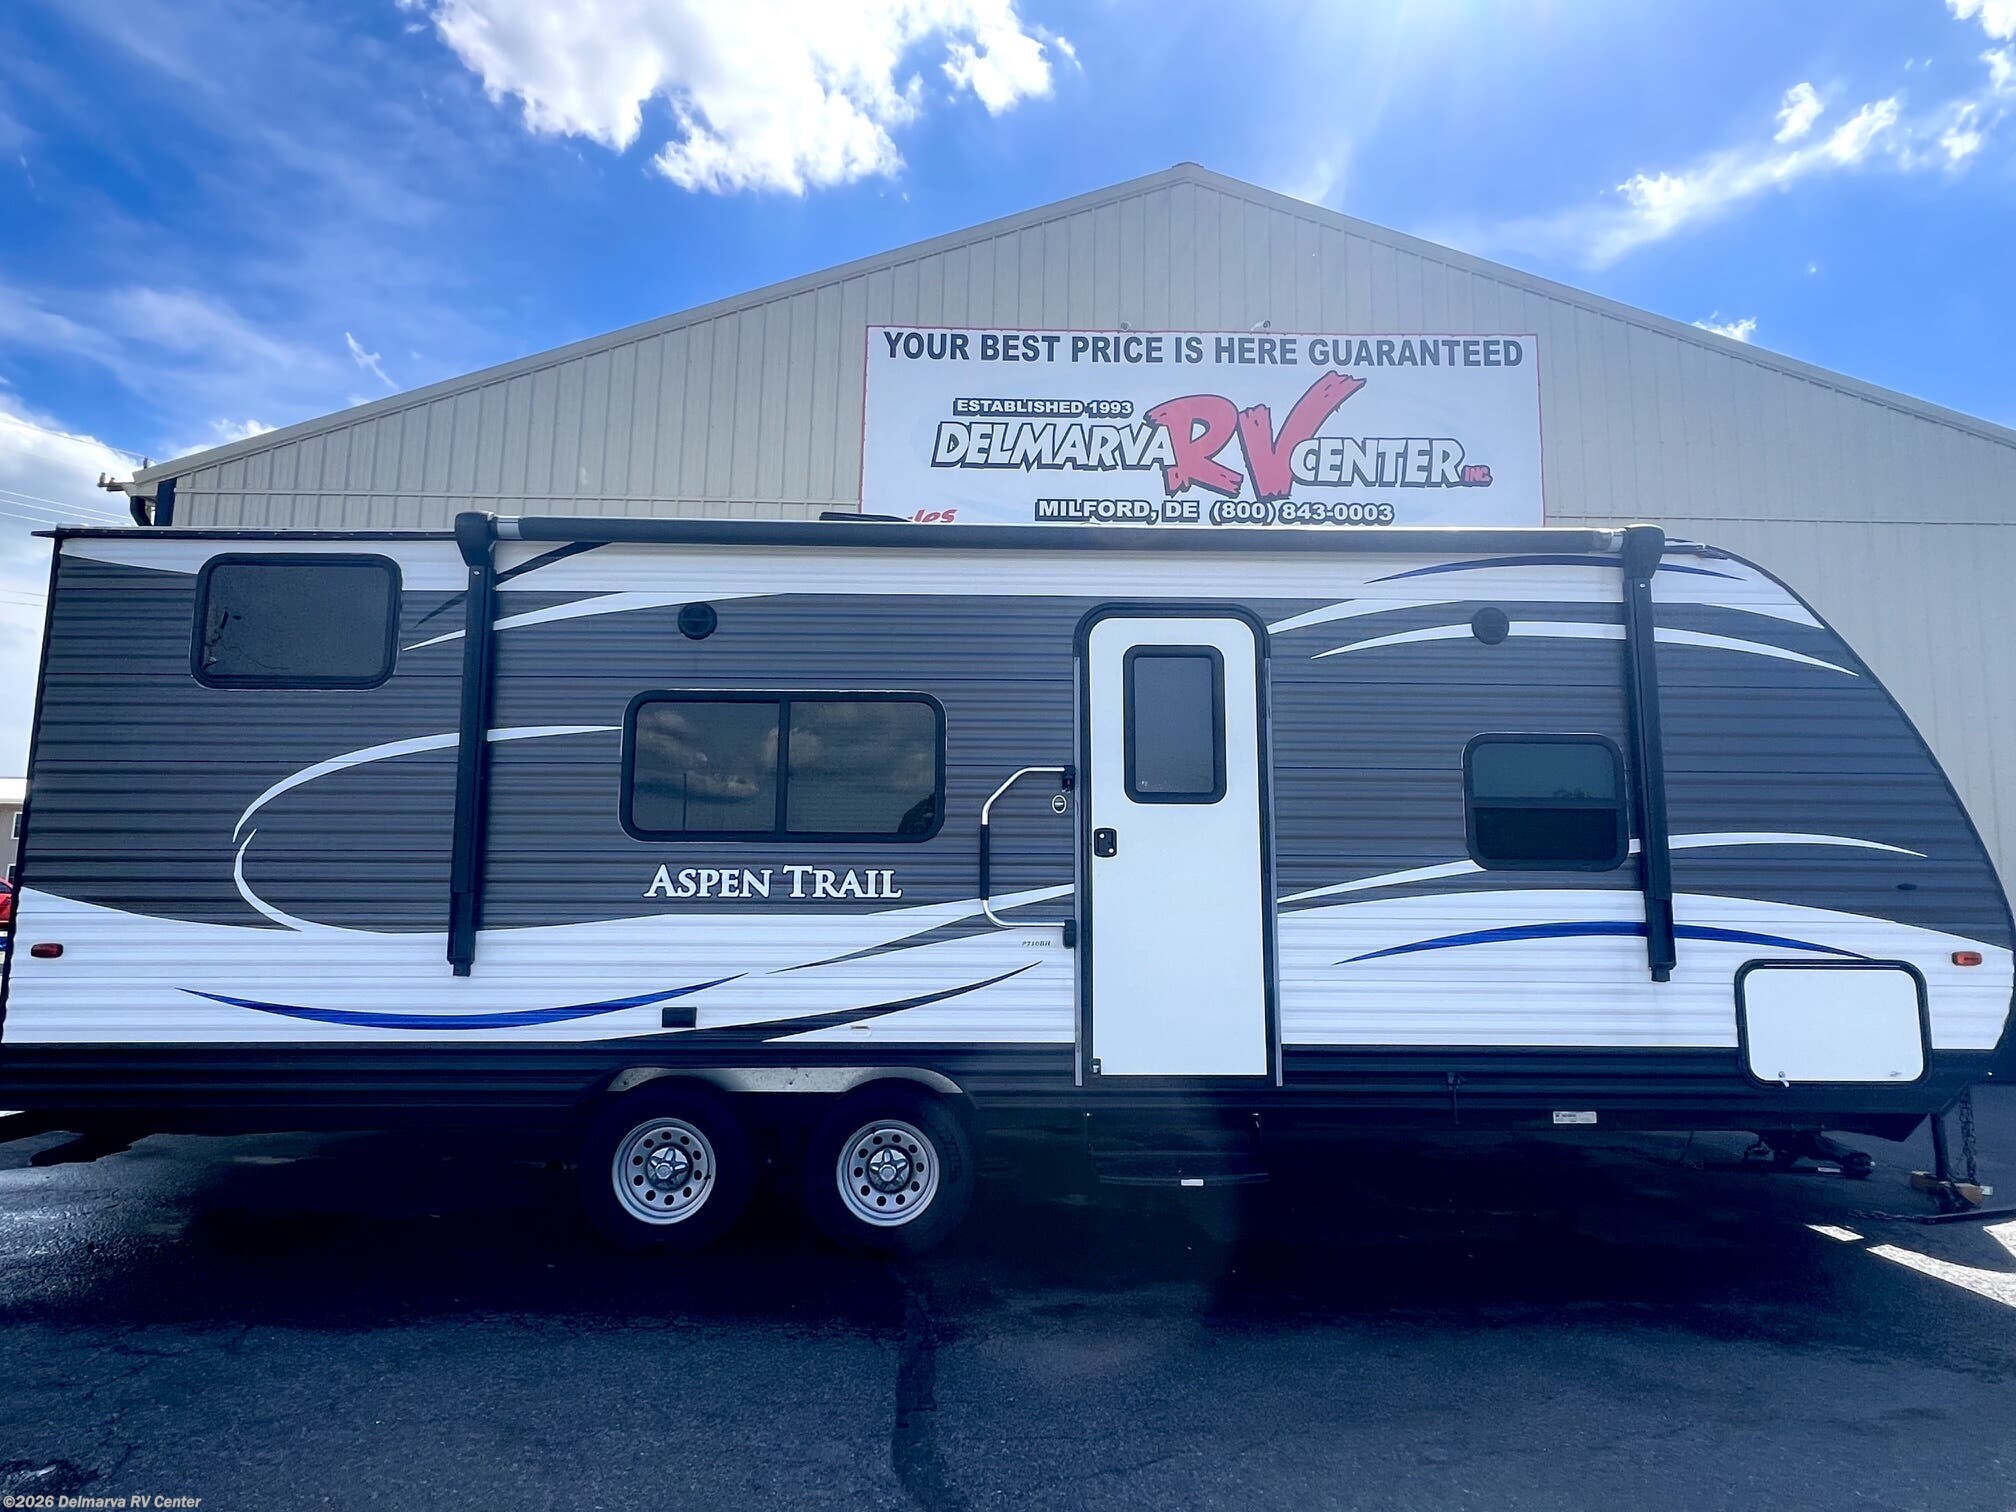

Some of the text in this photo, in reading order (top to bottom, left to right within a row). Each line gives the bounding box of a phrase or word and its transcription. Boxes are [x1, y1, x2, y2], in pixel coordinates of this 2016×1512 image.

[883, 331, 1524, 368] YOUR BEST PRICE IS HERE GUARANTEED
[955, 399, 1134, 417] ESTABLISHED 1993
[932, 421, 1178, 472] DELMARVA
[1143, 370, 1367, 500] RV
[1289, 437, 1466, 487] CENTER
[1035, 500, 1396, 525] MILFORD, DE (800) 843-0003
[643, 863, 902, 899] ASPEN TRAIL
